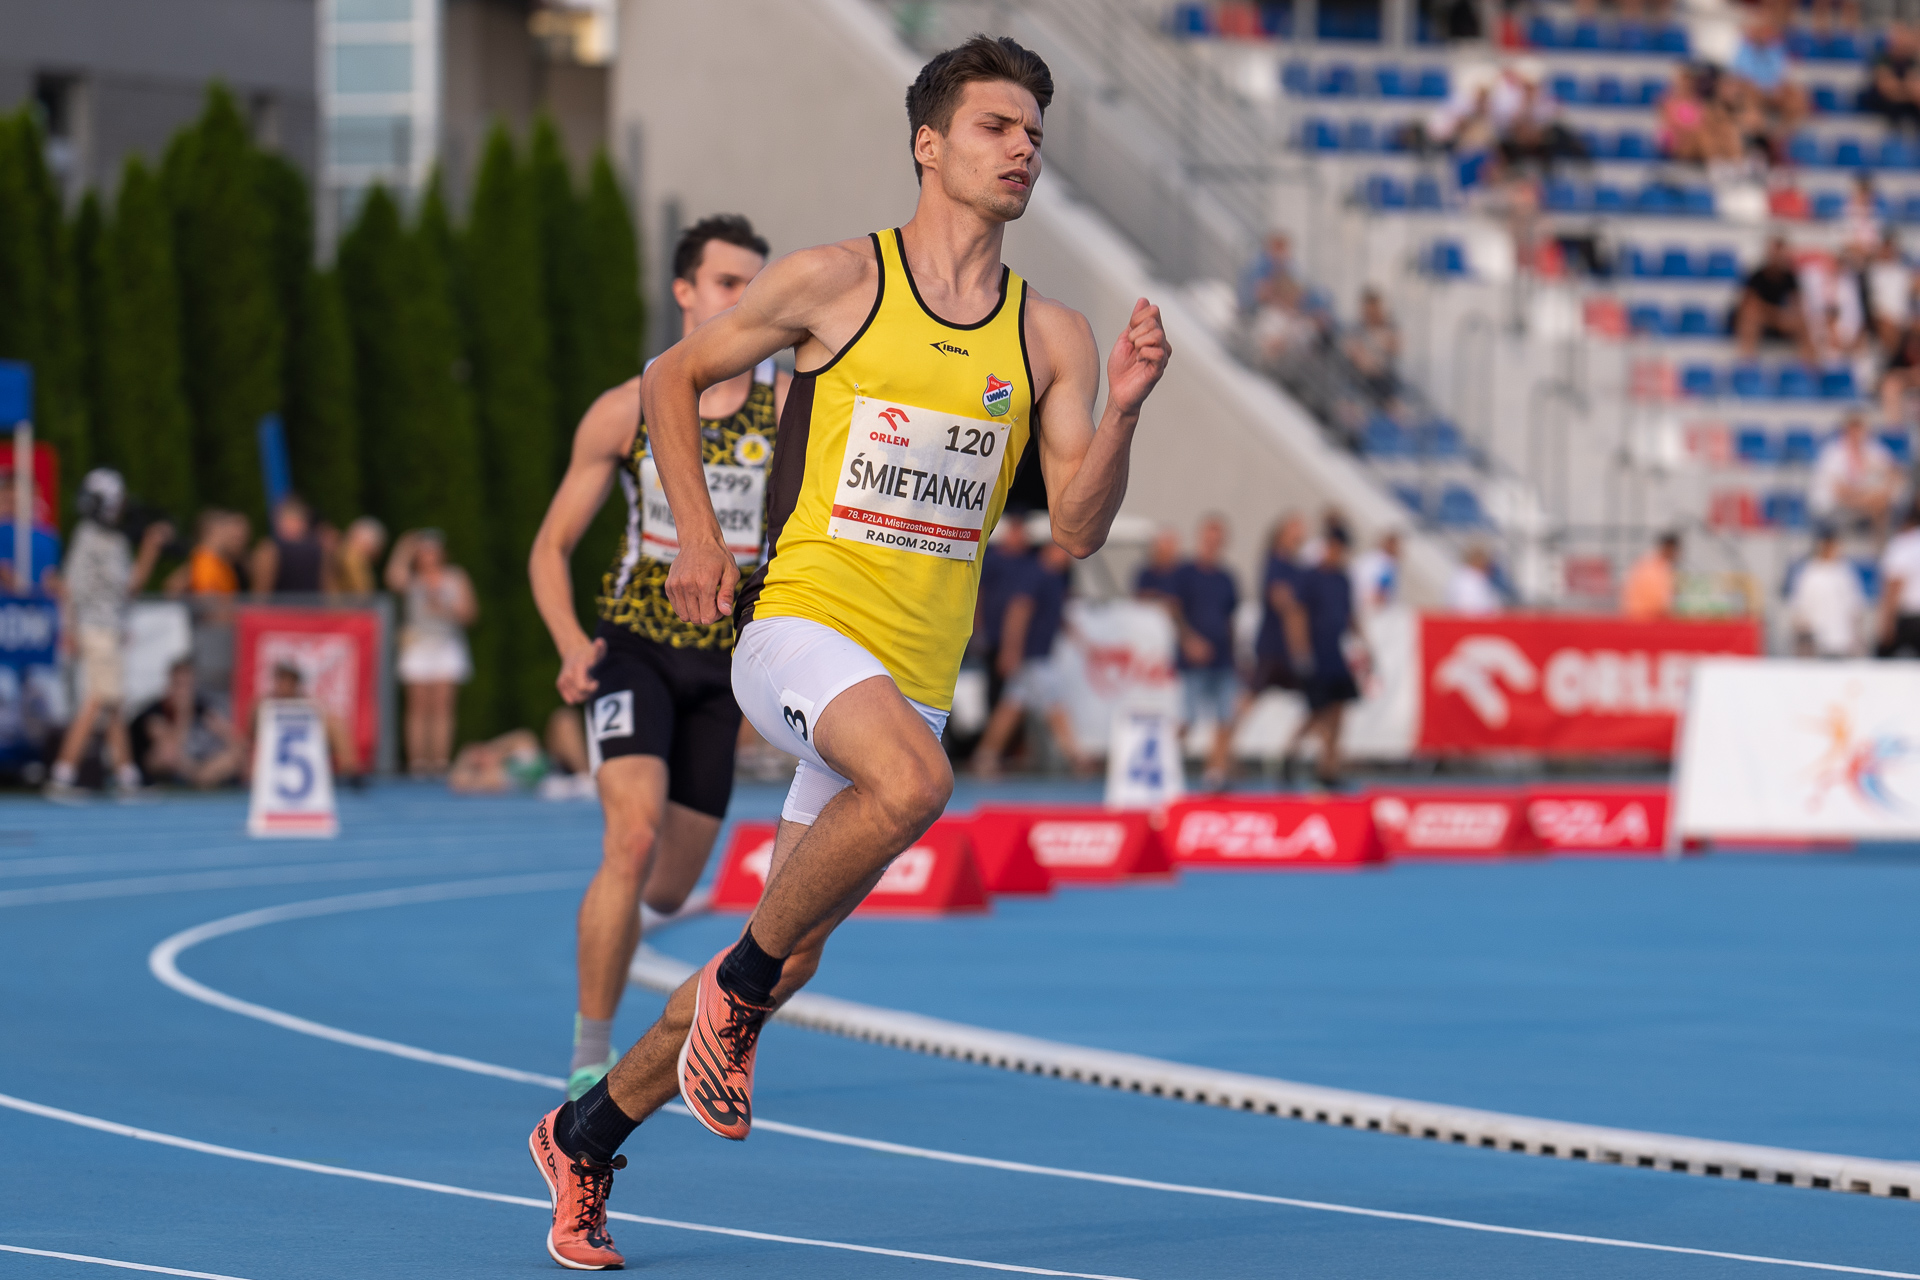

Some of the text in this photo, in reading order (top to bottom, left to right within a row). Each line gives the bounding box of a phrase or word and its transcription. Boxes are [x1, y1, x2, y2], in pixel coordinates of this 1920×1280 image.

[869, 431, 910, 448] ORLEN
[944, 425, 996, 458] 120
[709, 472, 753, 496] 299
[846, 452, 987, 511] ŚMIETANKA
[847, 509, 972, 540] 78. PZLA Mistrzostwa Polski U20
[865, 529, 952, 555] RADOM 2024
[1543, 646, 1694, 716] ORLE
[602, 700, 622, 733] 2
[783, 704, 808, 742] 3
[274, 720, 315, 801] 5
[1175, 808, 1337, 859] PZLA
